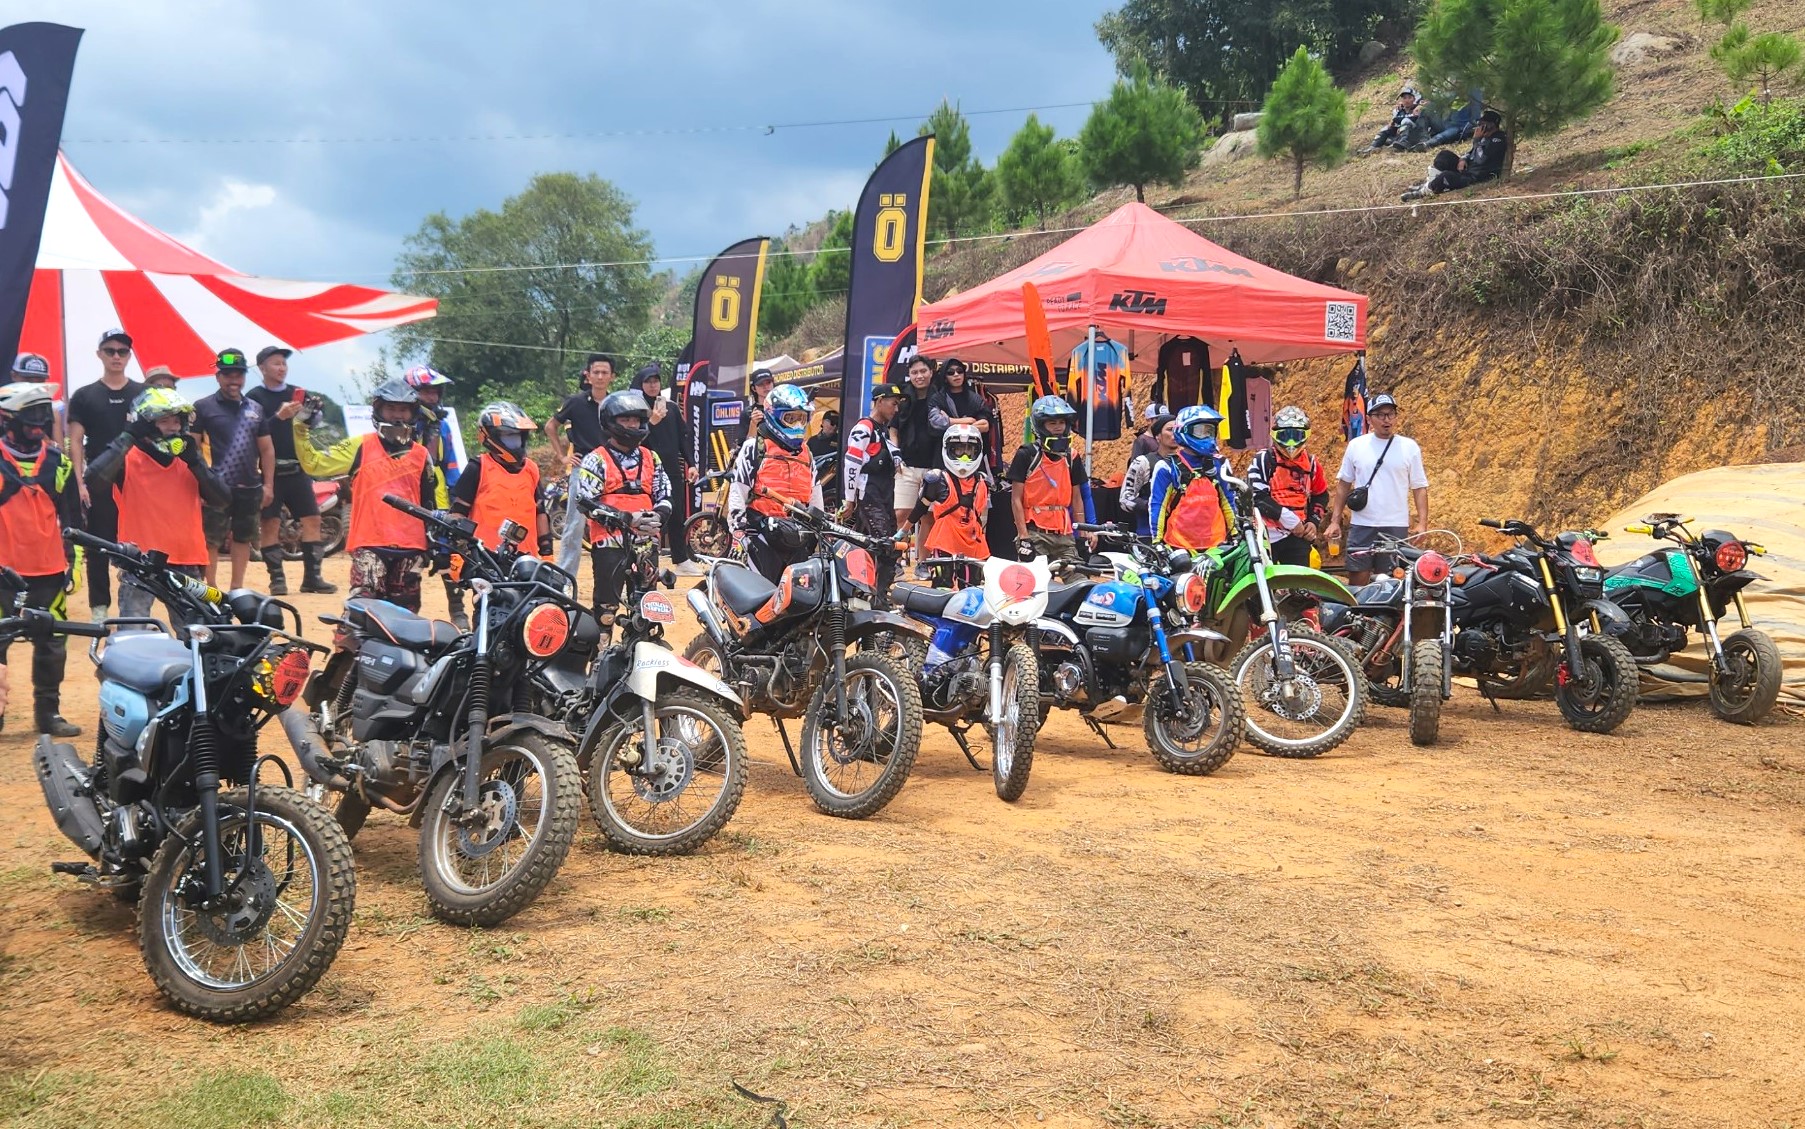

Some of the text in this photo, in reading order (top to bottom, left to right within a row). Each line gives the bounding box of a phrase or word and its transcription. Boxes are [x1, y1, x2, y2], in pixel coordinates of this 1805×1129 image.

[873, 193, 907, 262] Ö
[710, 275, 741, 331] Ö
[1109, 289, 1168, 316] KTM
[923, 319, 956, 341] KTM
[972, 362, 1033, 375] DISTRIBUT
[848, 467, 857, 490] FXR
[1016, 582, 1023, 591] 7
